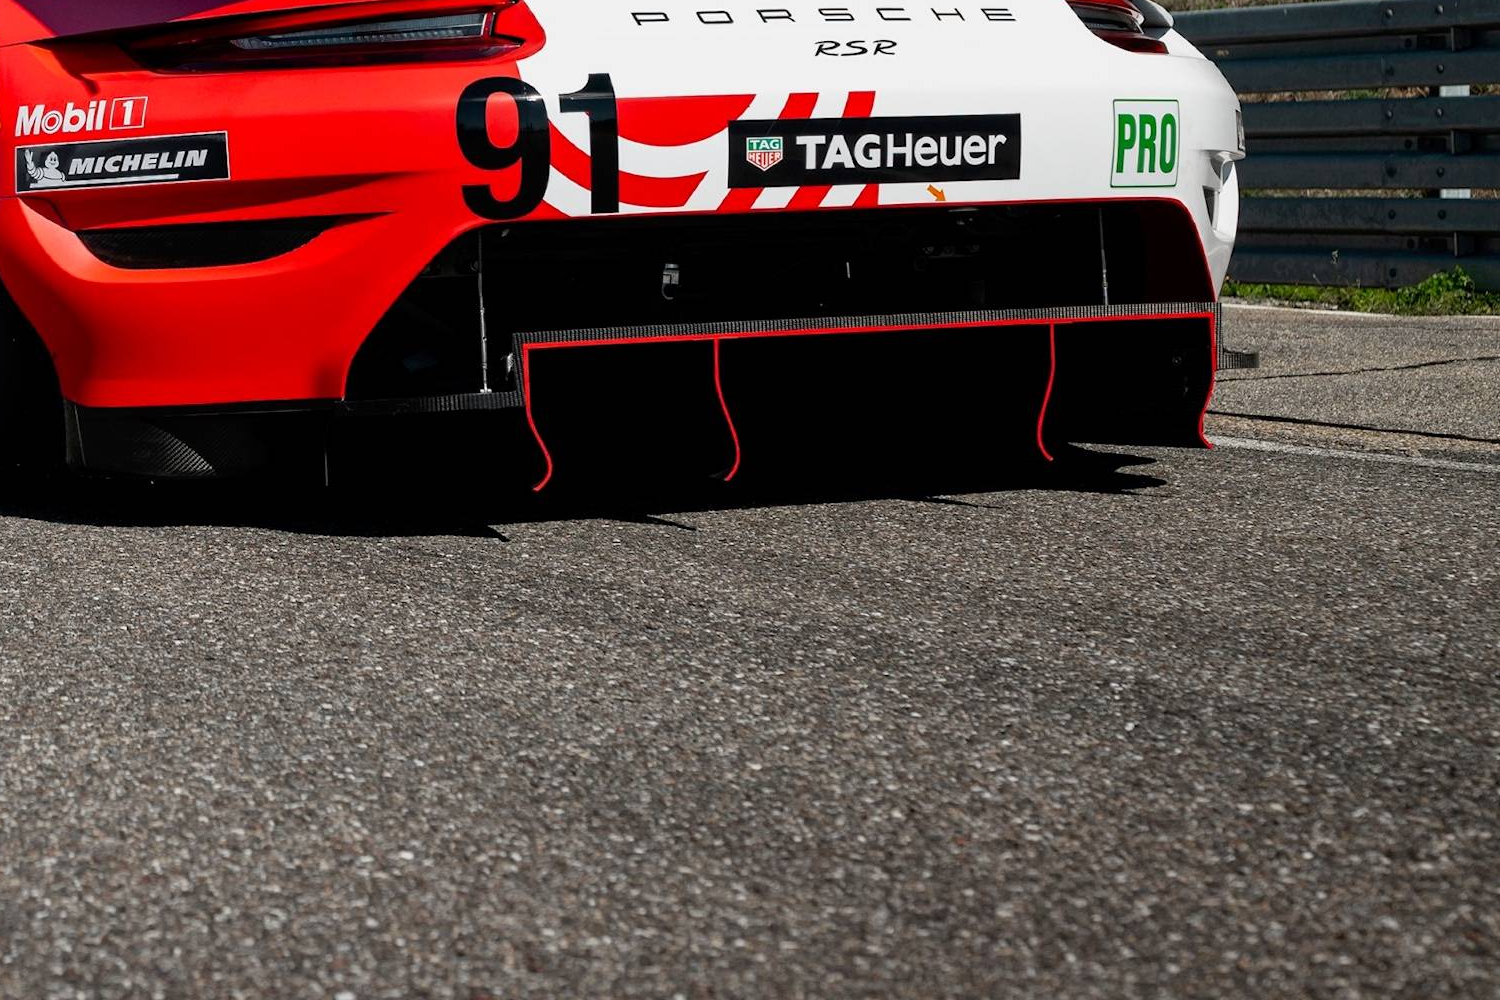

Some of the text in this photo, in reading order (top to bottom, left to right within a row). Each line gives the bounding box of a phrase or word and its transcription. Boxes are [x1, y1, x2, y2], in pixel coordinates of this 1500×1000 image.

[630, 7, 1017, 26] PORSCHE
[813, 39, 897, 57] RSR
[14, 100, 135, 137] Mobil 1
[455, 73, 620, 221] 91
[749, 139, 780, 150] TAG
[1115, 112, 1177, 174] PRO
[67, 149, 208, 176] MICHELIN
[749, 152, 781, 168] HEUER
